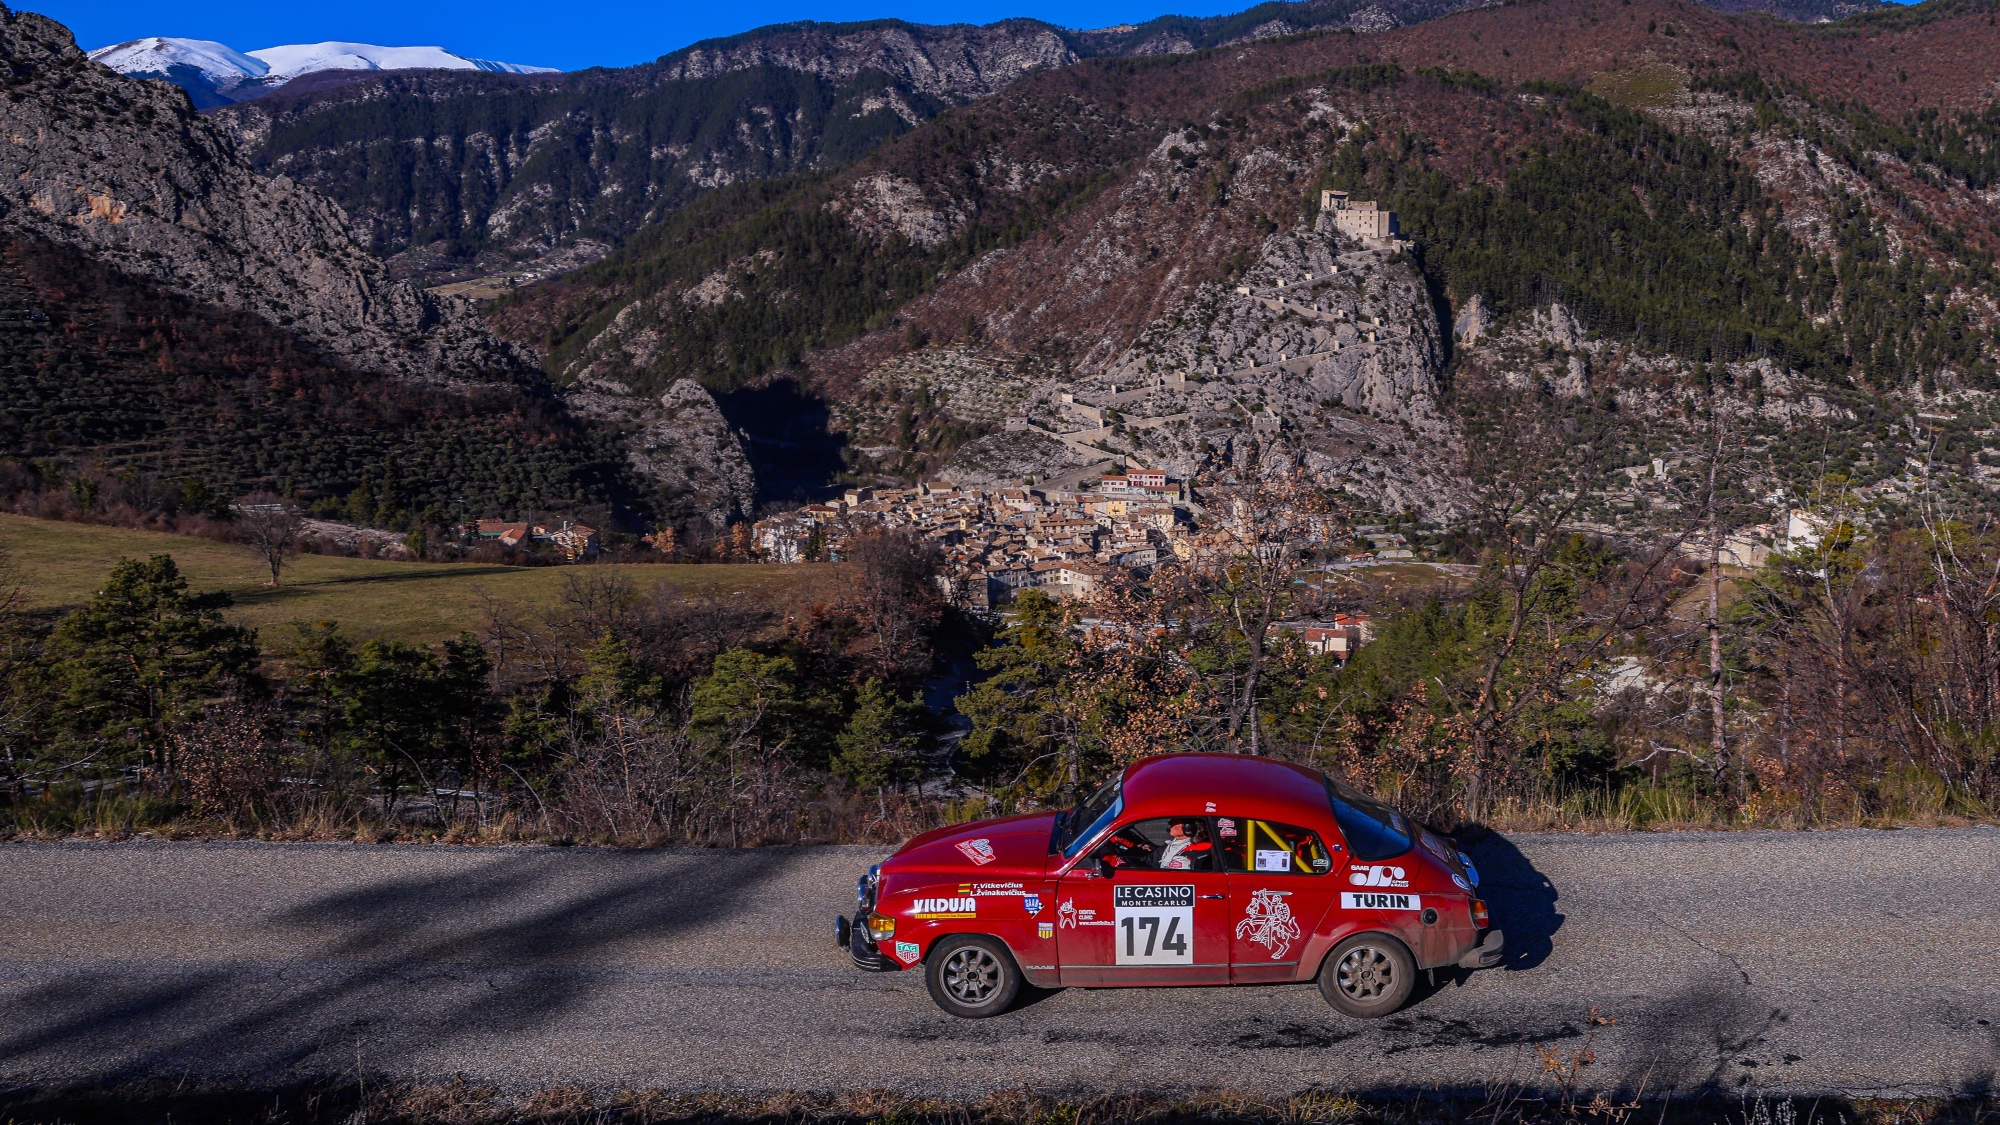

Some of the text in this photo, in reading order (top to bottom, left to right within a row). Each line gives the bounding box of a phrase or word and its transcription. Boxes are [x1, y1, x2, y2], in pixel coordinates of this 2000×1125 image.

[1117, 886, 1190, 898] LE CASINO
[914, 898, 976, 912] VILDUJA
[1024, 899, 1040, 907] SAAB
[1352, 894, 1410, 908] TURIN
[1121, 916, 1187, 956] 174
[898, 952, 917, 960] HEUER
